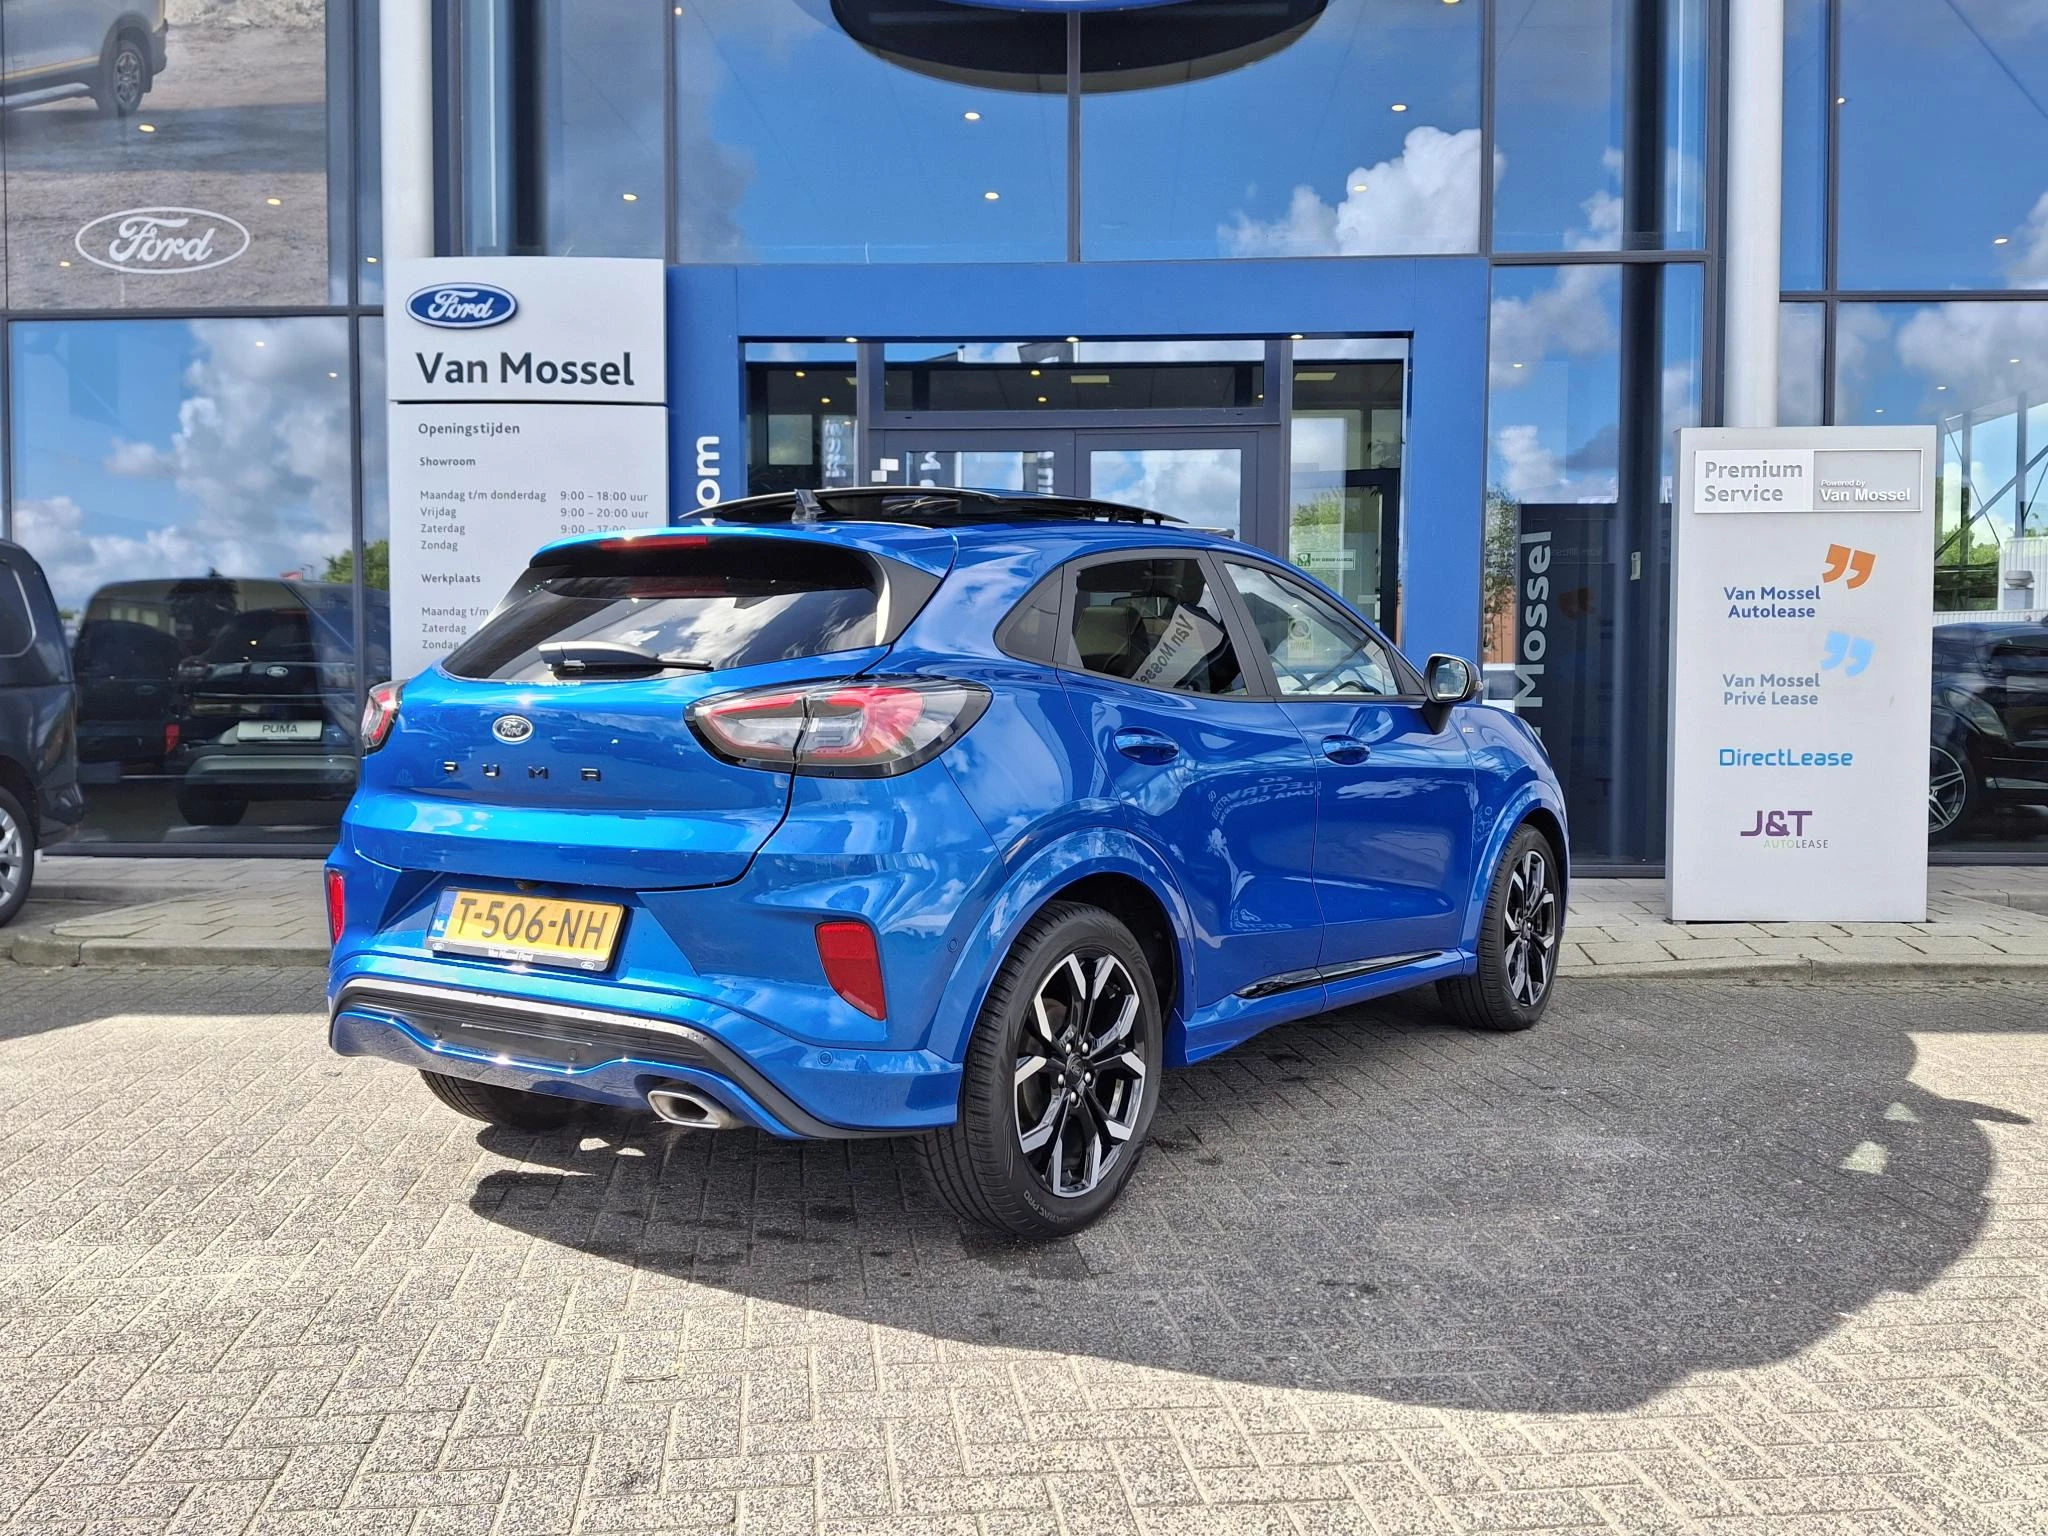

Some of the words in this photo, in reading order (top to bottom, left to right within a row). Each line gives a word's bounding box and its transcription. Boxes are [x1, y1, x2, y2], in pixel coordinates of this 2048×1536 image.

[109, 215, 214, 265] Ford
[427, 289, 496, 321] Ford
[416, 352, 488, 384] Van
[501, 351, 635, 387] Mossel
[418, 422, 521, 437] Openingstijden
[419, 456, 477, 467] Showroom
[1705, 460, 1803, 478] Premium
[696, 435, 721, 526] om
[1820, 480, 1854, 488] Powered
[1855, 480, 1867, 488] by
[420, 489, 466, 502] Maandag
[468, 490, 487, 501] t/m
[490, 489, 547, 503] donderdag
[560, 490, 585, 502] 9:00
[597, 490, 627, 502] 18:00
[630, 493, 649, 502] uur
[1704, 484, 1783, 502] Service
[1819, 487, 1850, 502] Van
[1854, 487, 1911, 502] Mossel
[420, 507, 457, 519] Vrijdag
[560, 507, 585, 519] 9:00
[596, 507, 628, 519] 20:00
[631, 510, 649, 519] uur
[420, 524, 466, 536] Zaterdag
[560, 524, 585, 535] 9:00
[420, 540, 458, 552] Zondag
[421, 573, 481, 585] Werkplaats
[1723, 586, 1755, 601] Van
[1760, 585, 1821, 601] Mossel
[421, 607, 468, 619] Maandag
[470, 607, 489, 618] t/m
[1727, 603, 1816, 618] Autolease
[1513, 531, 1552, 707] Mossel
[421, 623, 467, 636] Zaterdag
[1722, 673, 1755, 688] Van
[1760, 673, 1820, 688] Mossel
[1723, 690, 1766, 706] Privé
[1771, 691, 1819, 706] Lease
[262, 724, 298, 734] PUMA
[1719, 748, 1854, 767] DirectLease
[443, 761, 602, 781] PUMA
[1740, 811, 1813, 837] J&T
[1763, 840, 1829, 849] AUTOLEASE
[432, 919, 446, 932] NL
[457, 897, 609, 951] T-506-NH
